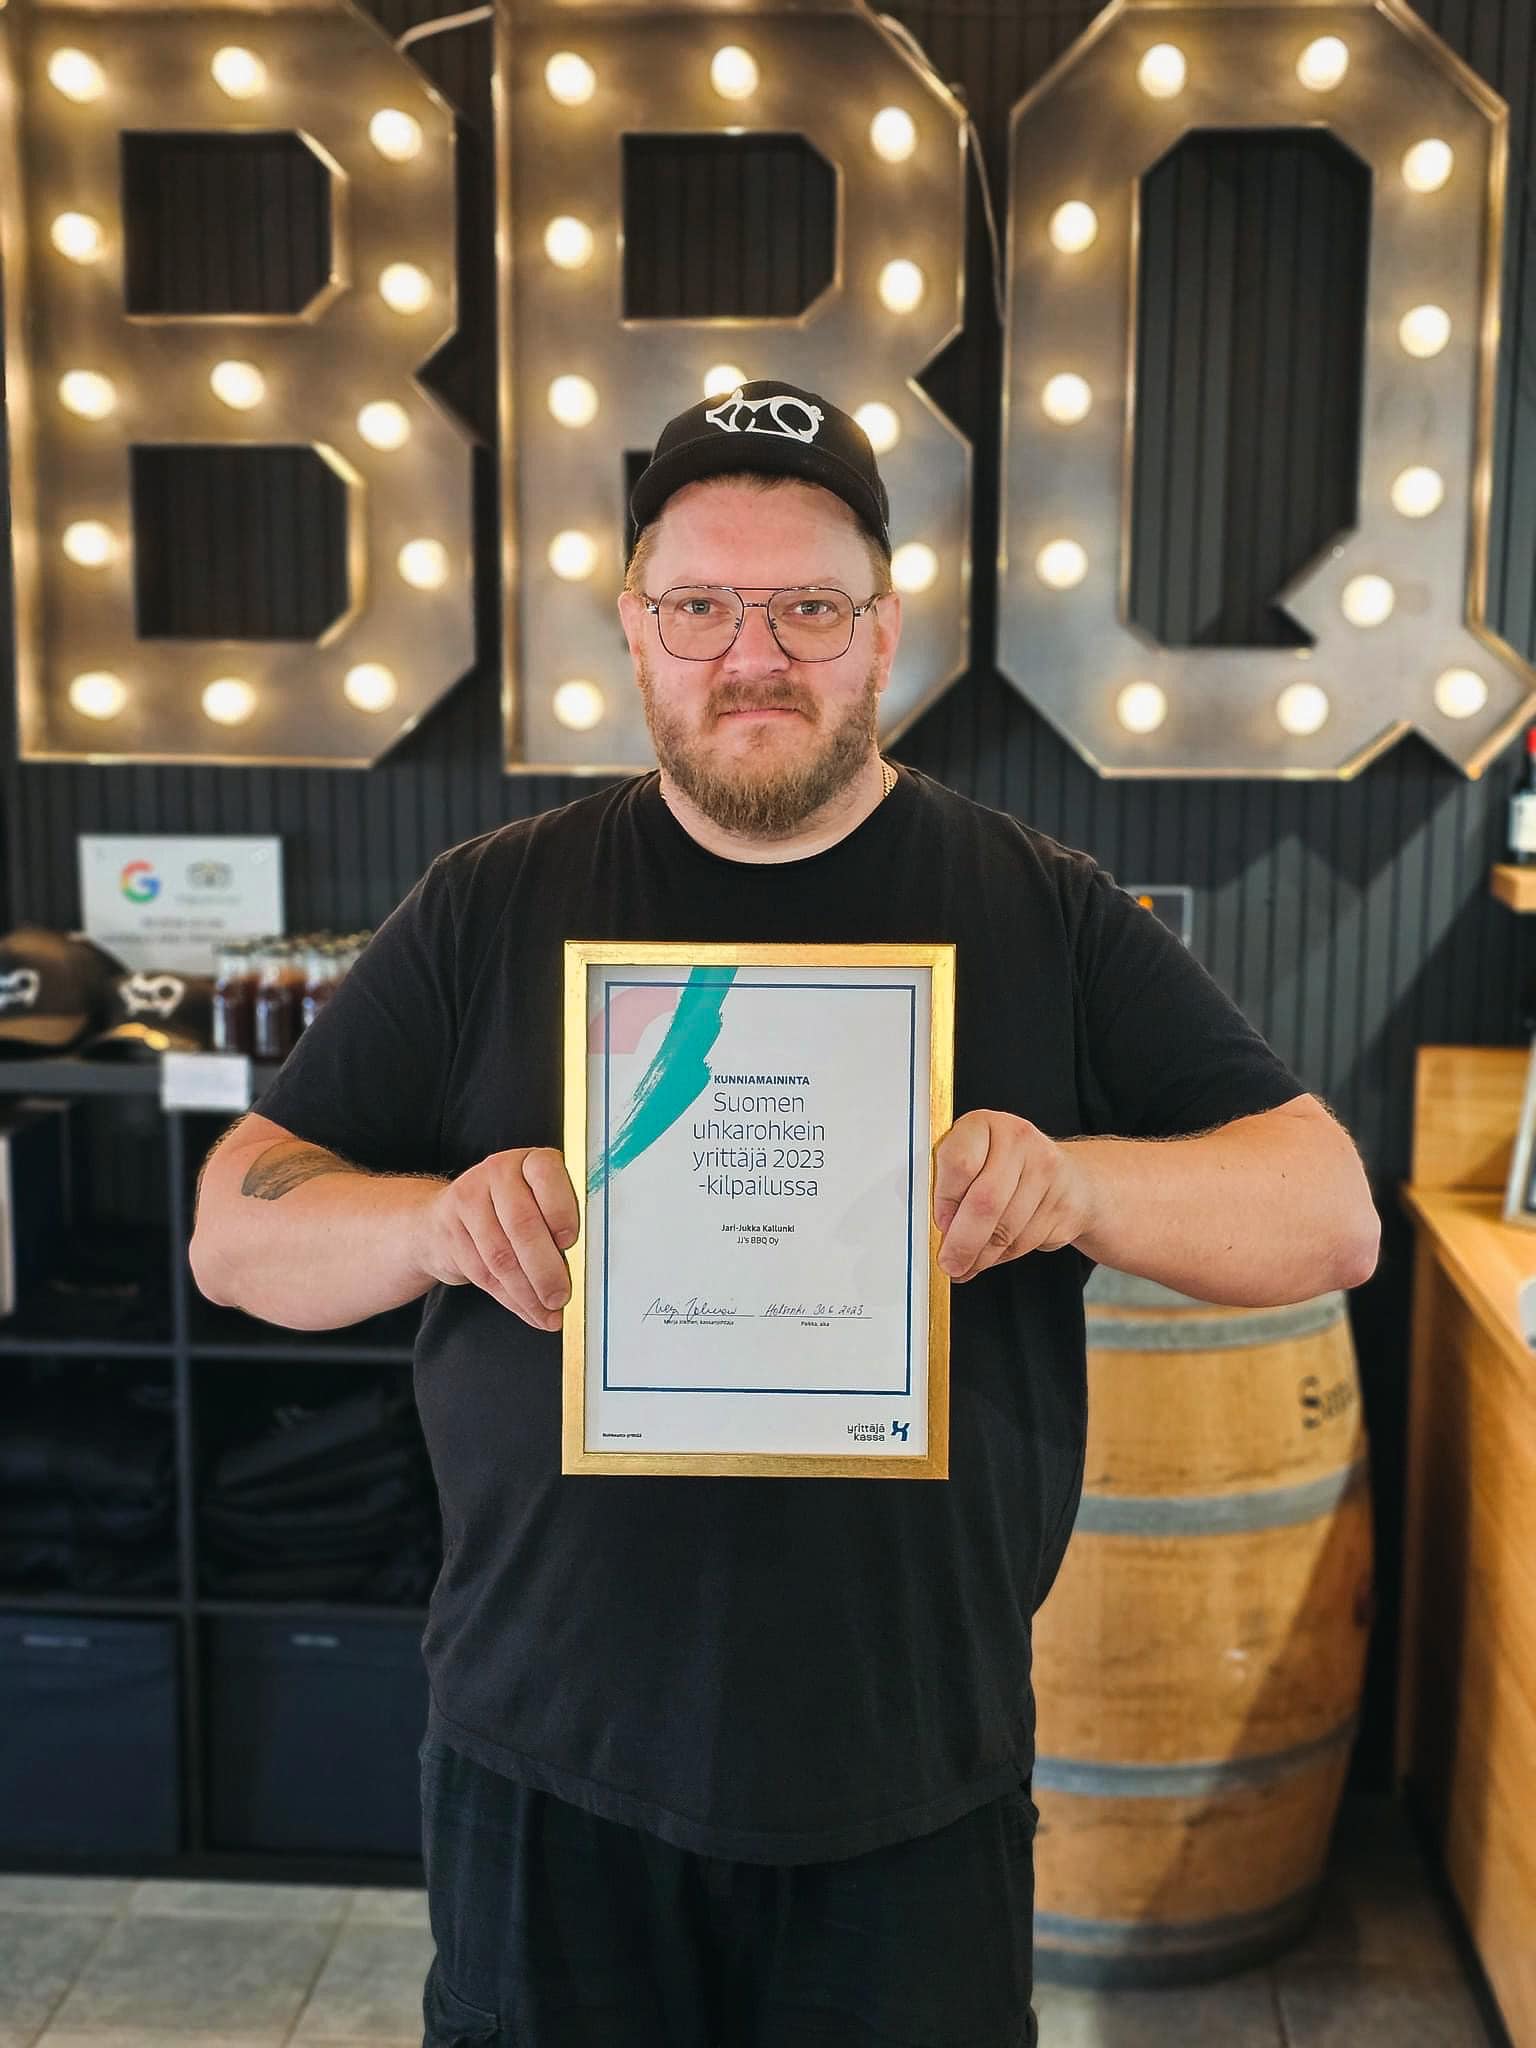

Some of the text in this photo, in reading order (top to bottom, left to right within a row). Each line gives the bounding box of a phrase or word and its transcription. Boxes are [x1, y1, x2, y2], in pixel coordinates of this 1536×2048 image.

[0, 0, 1536, 780] BBQ
[713, 1074, 811, 1087] KUNNIAMAININTA
[713, 1091, 805, 1114] Suomen
[692, 1119, 826, 1142] uhkarohkein
[692, 1147, 826, 1172] yrittäjä 2023
[698, 1174, 819, 1200] -kilpailussa
[720, 1223, 796, 1233] Jari-Jukka Kallunki
[750, 1236, 768, 1246] BBQ
[768, 1236, 780, 1246] Oy
[846, 1422, 886, 1435] yrittäjä
[853, 1432, 886, 1442] kassa
